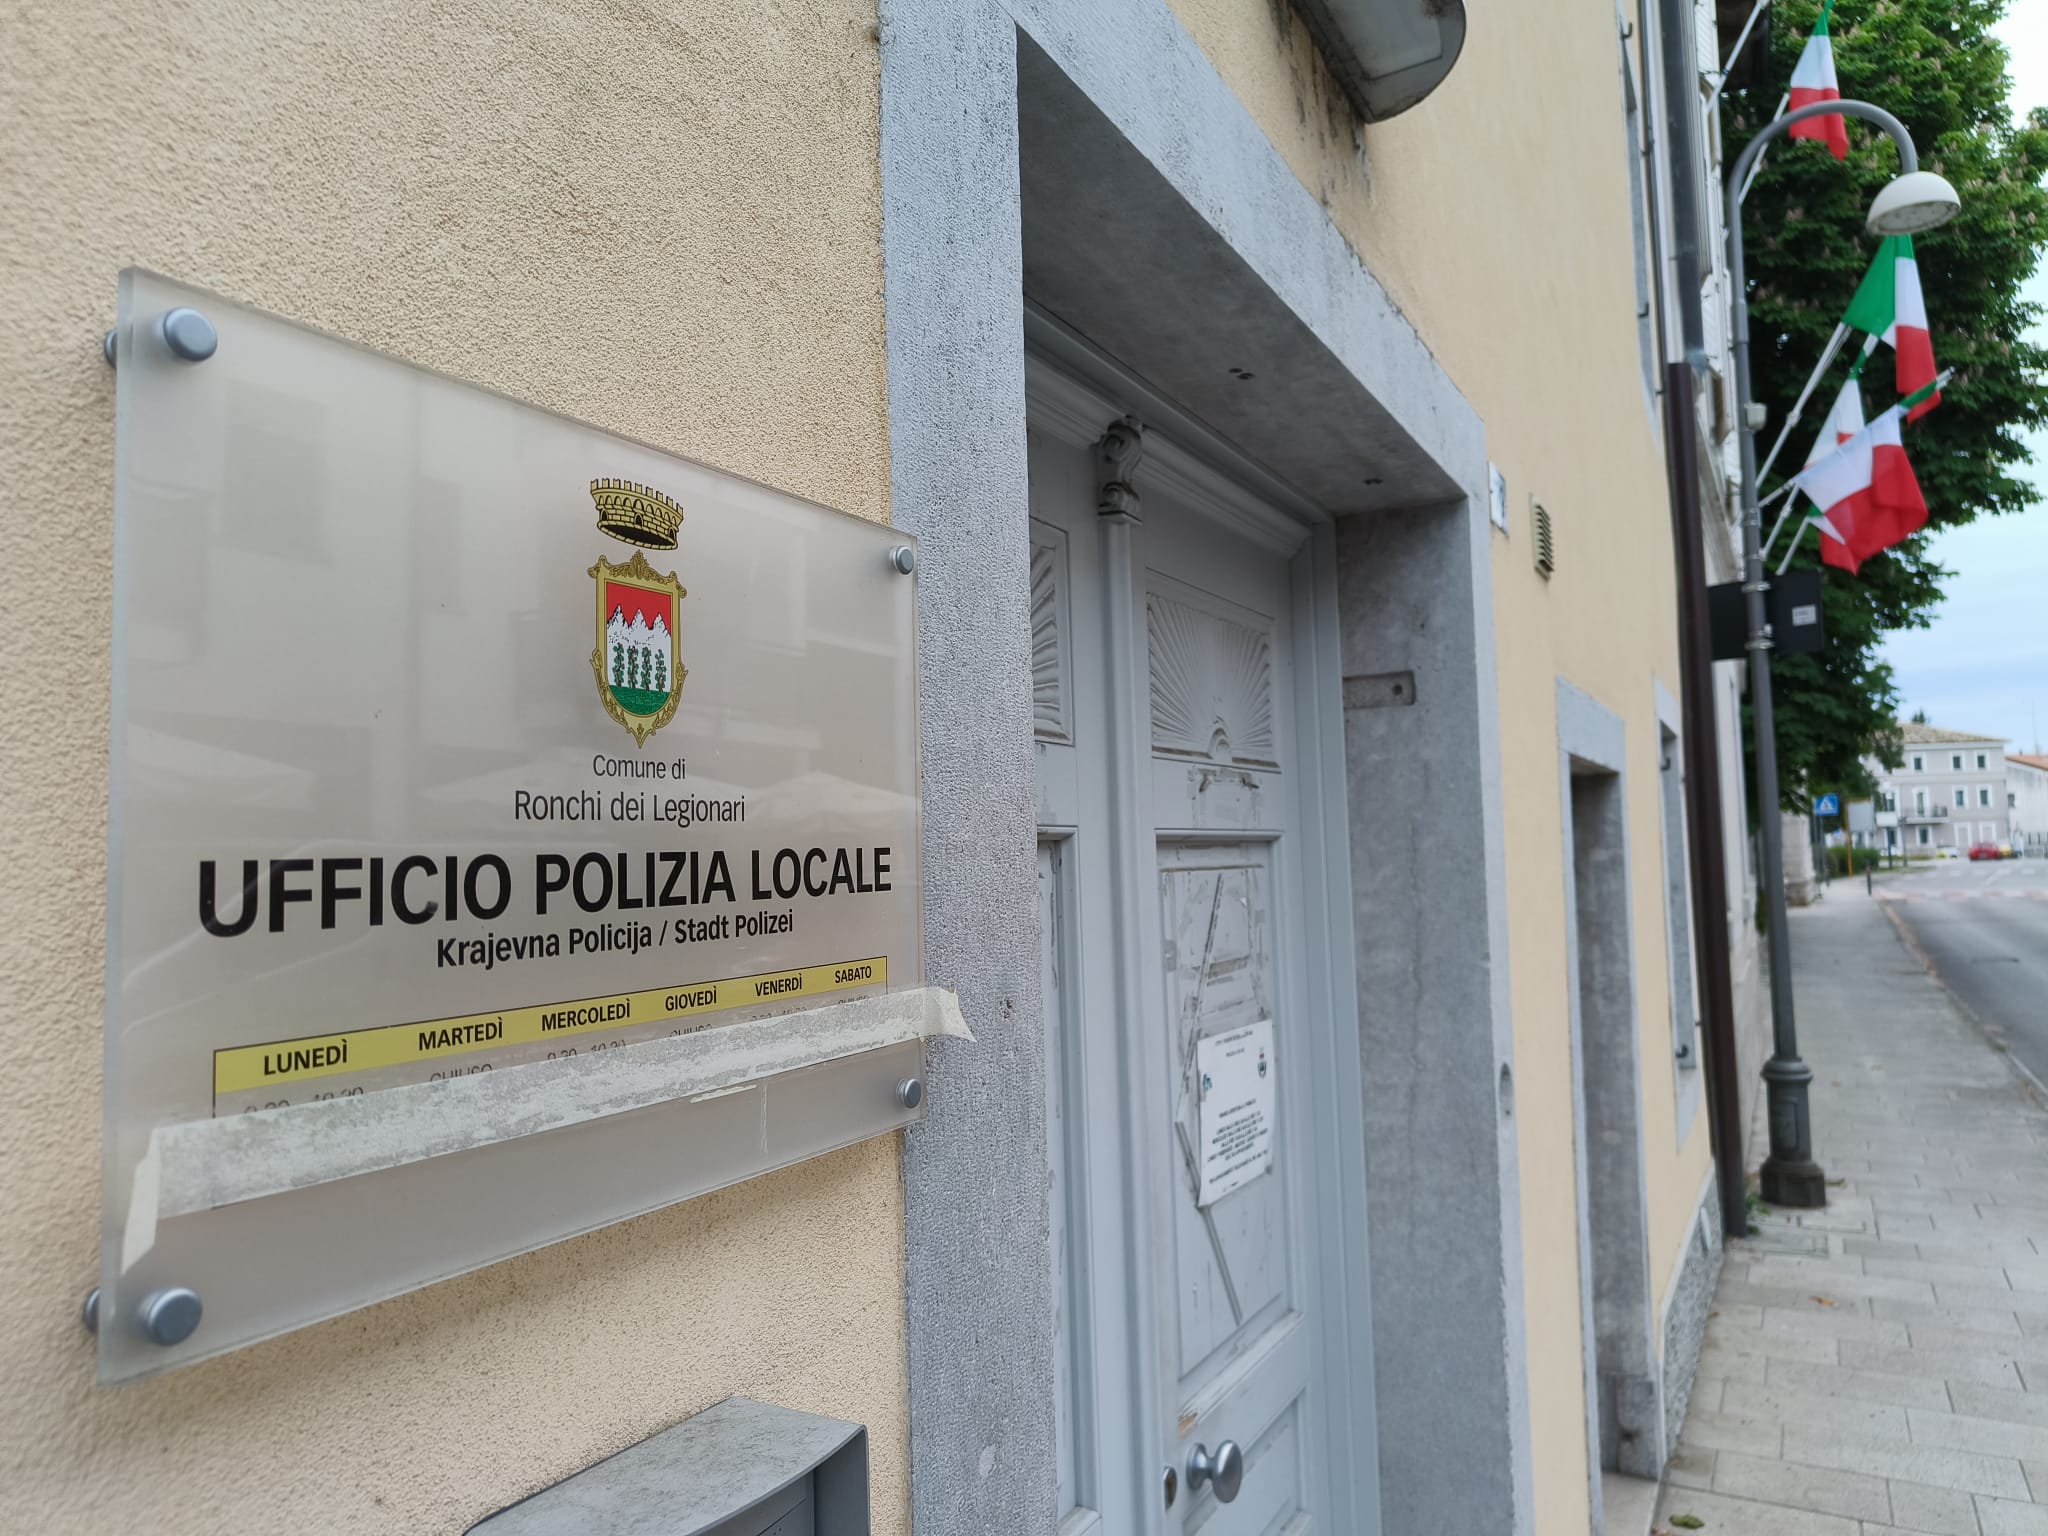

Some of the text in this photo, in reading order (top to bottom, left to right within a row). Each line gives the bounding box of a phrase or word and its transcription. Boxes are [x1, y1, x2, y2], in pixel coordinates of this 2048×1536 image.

[593, 754, 686, 780] Comune di
[515, 790, 745, 828] Ronchi dei Legionari
[199, 847, 892, 938] UFFICIO POLIZIA LOCALE
[437, 908, 794, 971] Krajevna Policija / Stadt Polizei
[263, 965, 872, 1076] LUNEDÌ MARTEDÌ MERCOLEDÌ GIOVEDÌ VENERDÌ SABATO
